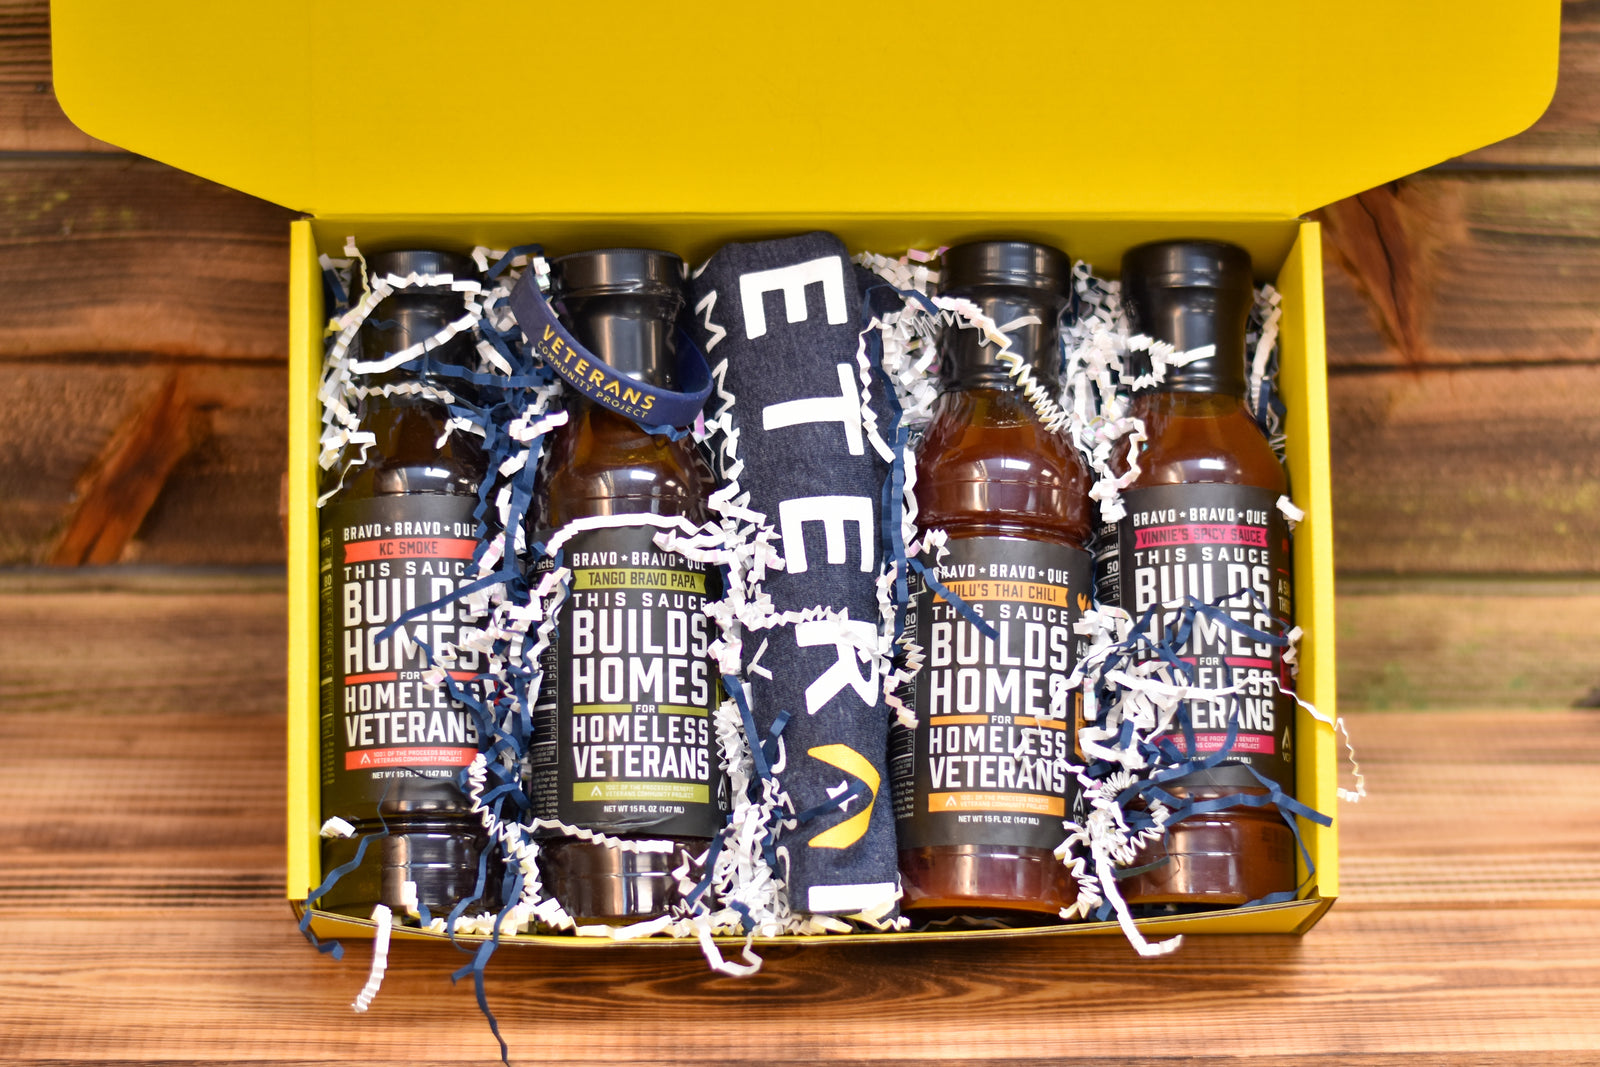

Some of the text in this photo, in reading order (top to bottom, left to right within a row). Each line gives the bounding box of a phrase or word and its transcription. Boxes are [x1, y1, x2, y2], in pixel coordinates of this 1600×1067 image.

[542, 324, 656, 410] VETERANS
[537, 341, 649, 419] COMMUNITY PROJECT
[1133, 507, 1268, 527] BRAVO BRAVO QUE
[344, 524, 381, 541] BRAVO
[394, 521, 441, 536] BRAVO
[1141, 527, 1262, 545] VINNIE'S SPICY SAUCE
[380, 541, 438, 556] KC SMOKE
[1134, 548, 1270, 566] THIS SAUCE
[573, 552, 617, 567] BRAVO
[631, 551, 676, 567] BRAVO
[1106, 560, 1118, 575] 50
[344, 561, 473, 581] THIS SAUC
[588, 572, 696, 589] TANGO BRAVO PAPA
[989, 564, 1036, 579] BRAVO
[1047, 568, 1069, 585] QUE
[947, 584, 1056, 602] ULU'S THAI CHILI
[1134, 563, 1271, 613] BUILDS
[344, 577, 479, 626] BUILDS
[573, 592, 706, 610] THIS SAUCE
[905, 613, 916, 625] 80
[932, 604, 1069, 625] THS SAUCE
[573, 608, 708, 658] BUILDS
[344, 624, 479, 674] HOMES
[931, 620, 1068, 671] BUILDS
[1199, 657, 1220, 666] FOR
[400, 671, 420, 680] FOR
[573, 657, 708, 706] HOMES
[1173, 667, 1274, 698] MELESS
[930, 668, 1067, 719] HOMES
[635, 704, 655, 713] FOR
[1166, 696, 1274, 732] ERANS
[345, 711, 479, 747] VETERANS
[991, 715, 1011, 724] FOR
[573, 715, 709, 746] HOMELESS
[929, 725, 1066, 759] HOMELESS
[573, 745, 709, 781] VETERANS
[372, 771, 384, 779] NET
[929, 755, 1066, 794] VETERANS
[603, 805, 616, 813] NET
[648, 805, 657, 813] OZ
[674, 806, 685, 814] ML)
[958, 815, 971, 823] NET
[1014, 816, 1027, 824] (147
[1028, 816, 1040, 825] ML)
